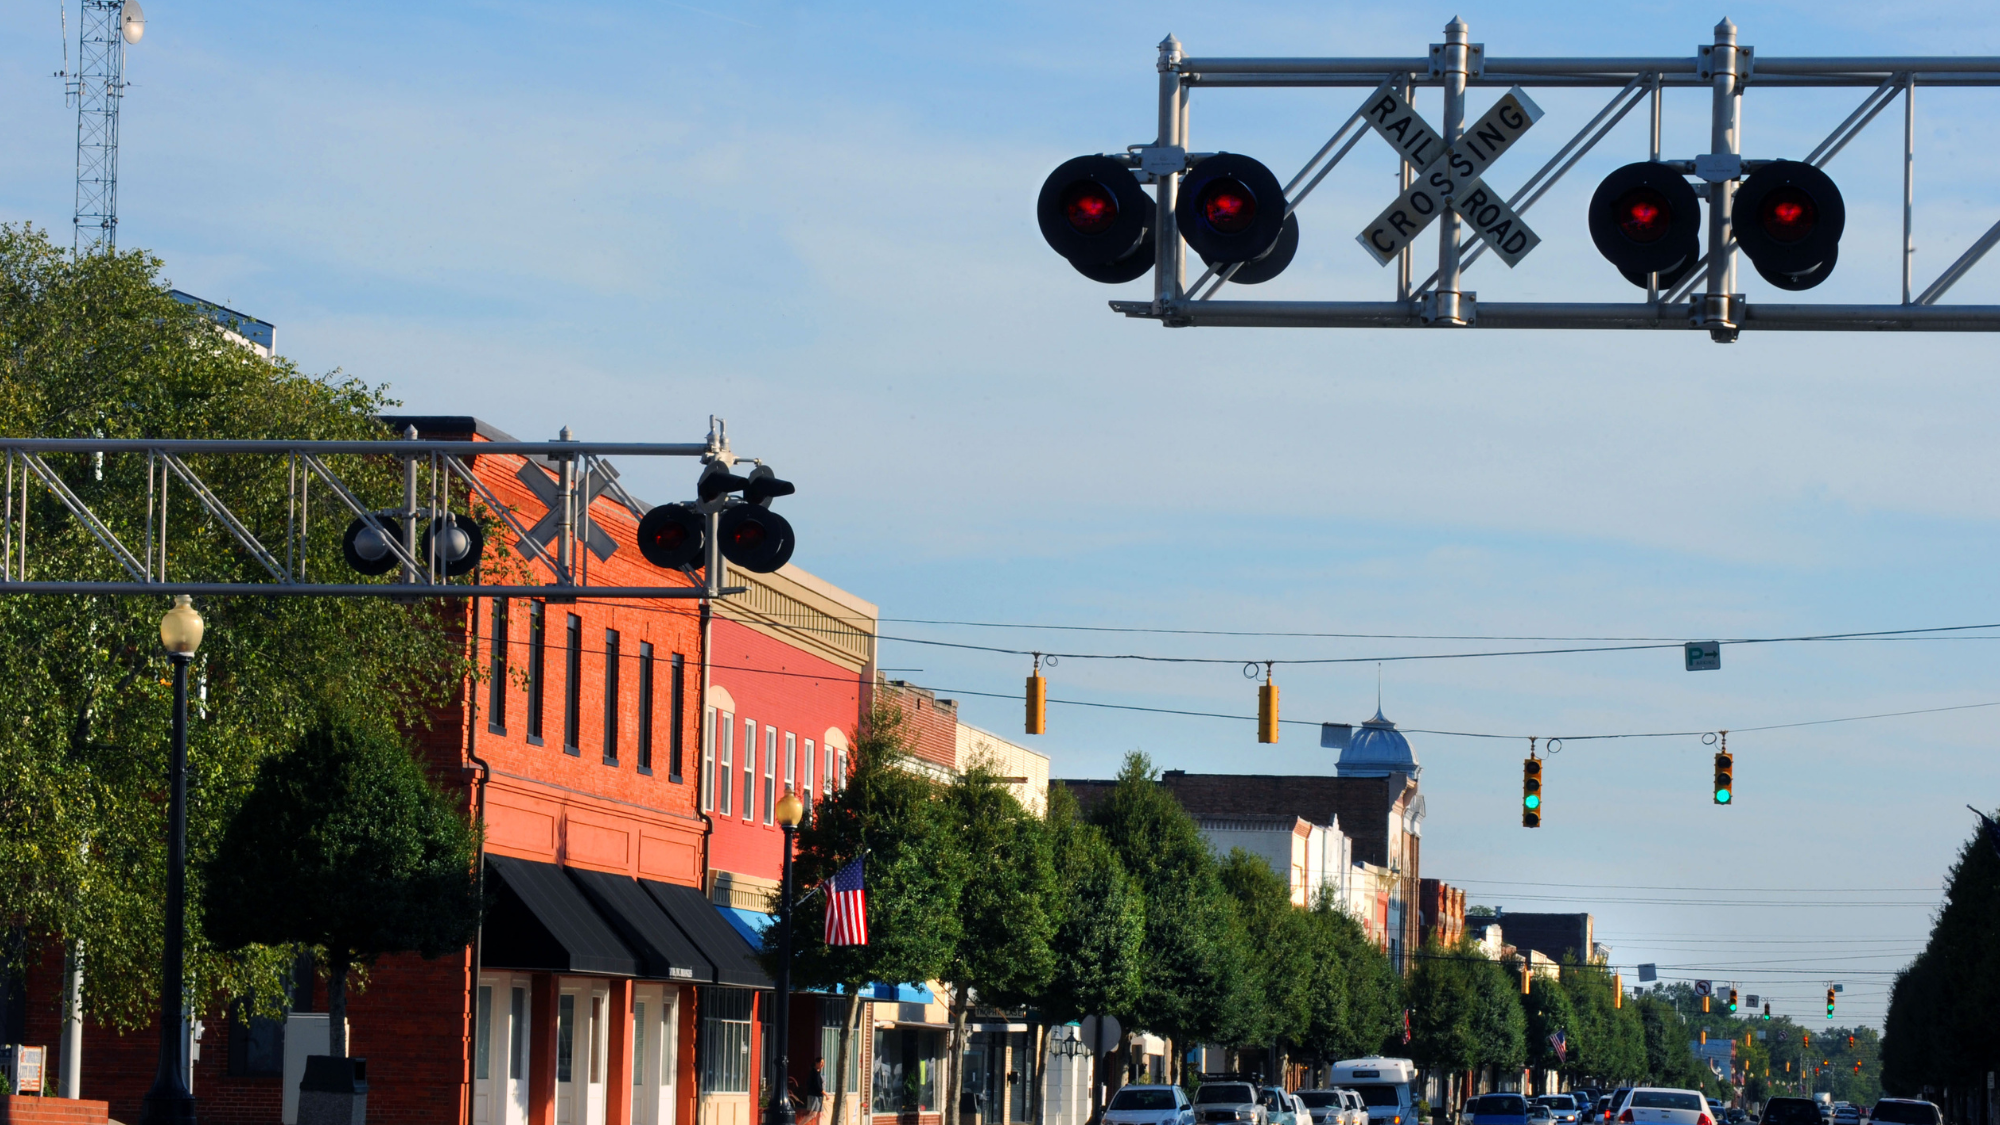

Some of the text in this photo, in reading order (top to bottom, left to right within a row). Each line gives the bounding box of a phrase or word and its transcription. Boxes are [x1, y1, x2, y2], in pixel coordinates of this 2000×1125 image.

[1370, 95, 1527, 255] RAIL ROAD
[1371, 105, 1524, 253] CROSSING
